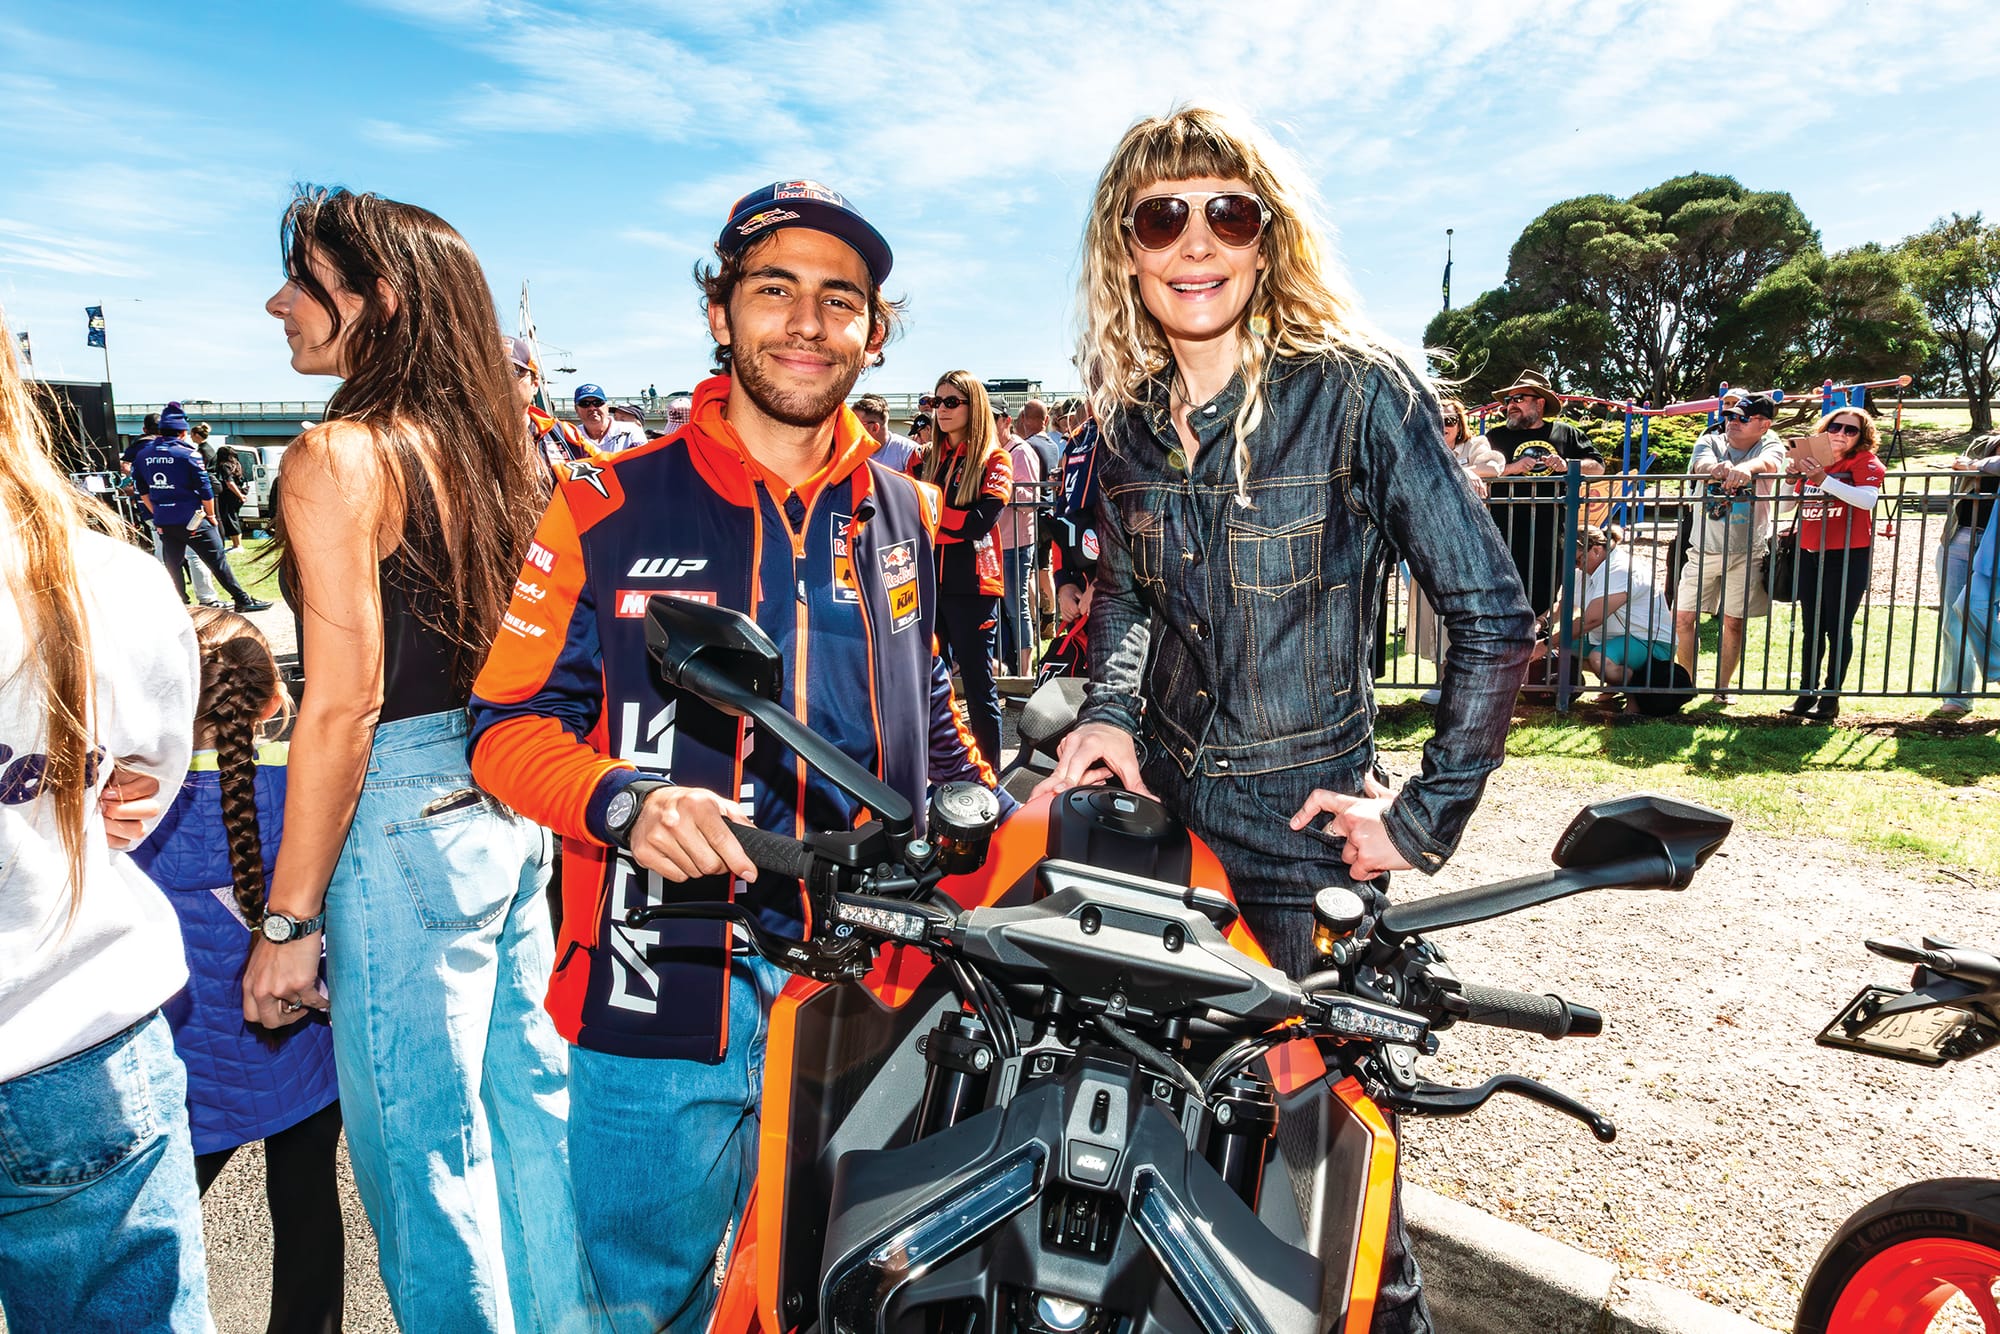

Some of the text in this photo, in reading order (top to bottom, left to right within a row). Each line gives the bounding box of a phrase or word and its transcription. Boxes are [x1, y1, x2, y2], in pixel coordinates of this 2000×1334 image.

[145, 456, 175, 467] prima
[1802, 506, 1843, 519] UCATI
[525, 541, 554, 573] TUL
[626, 558, 709, 578] WP
[896, 590, 914, 611] KTM
[608, 699, 677, 1015] RACG
[1869, 1211, 1957, 1240] MICHELIN
